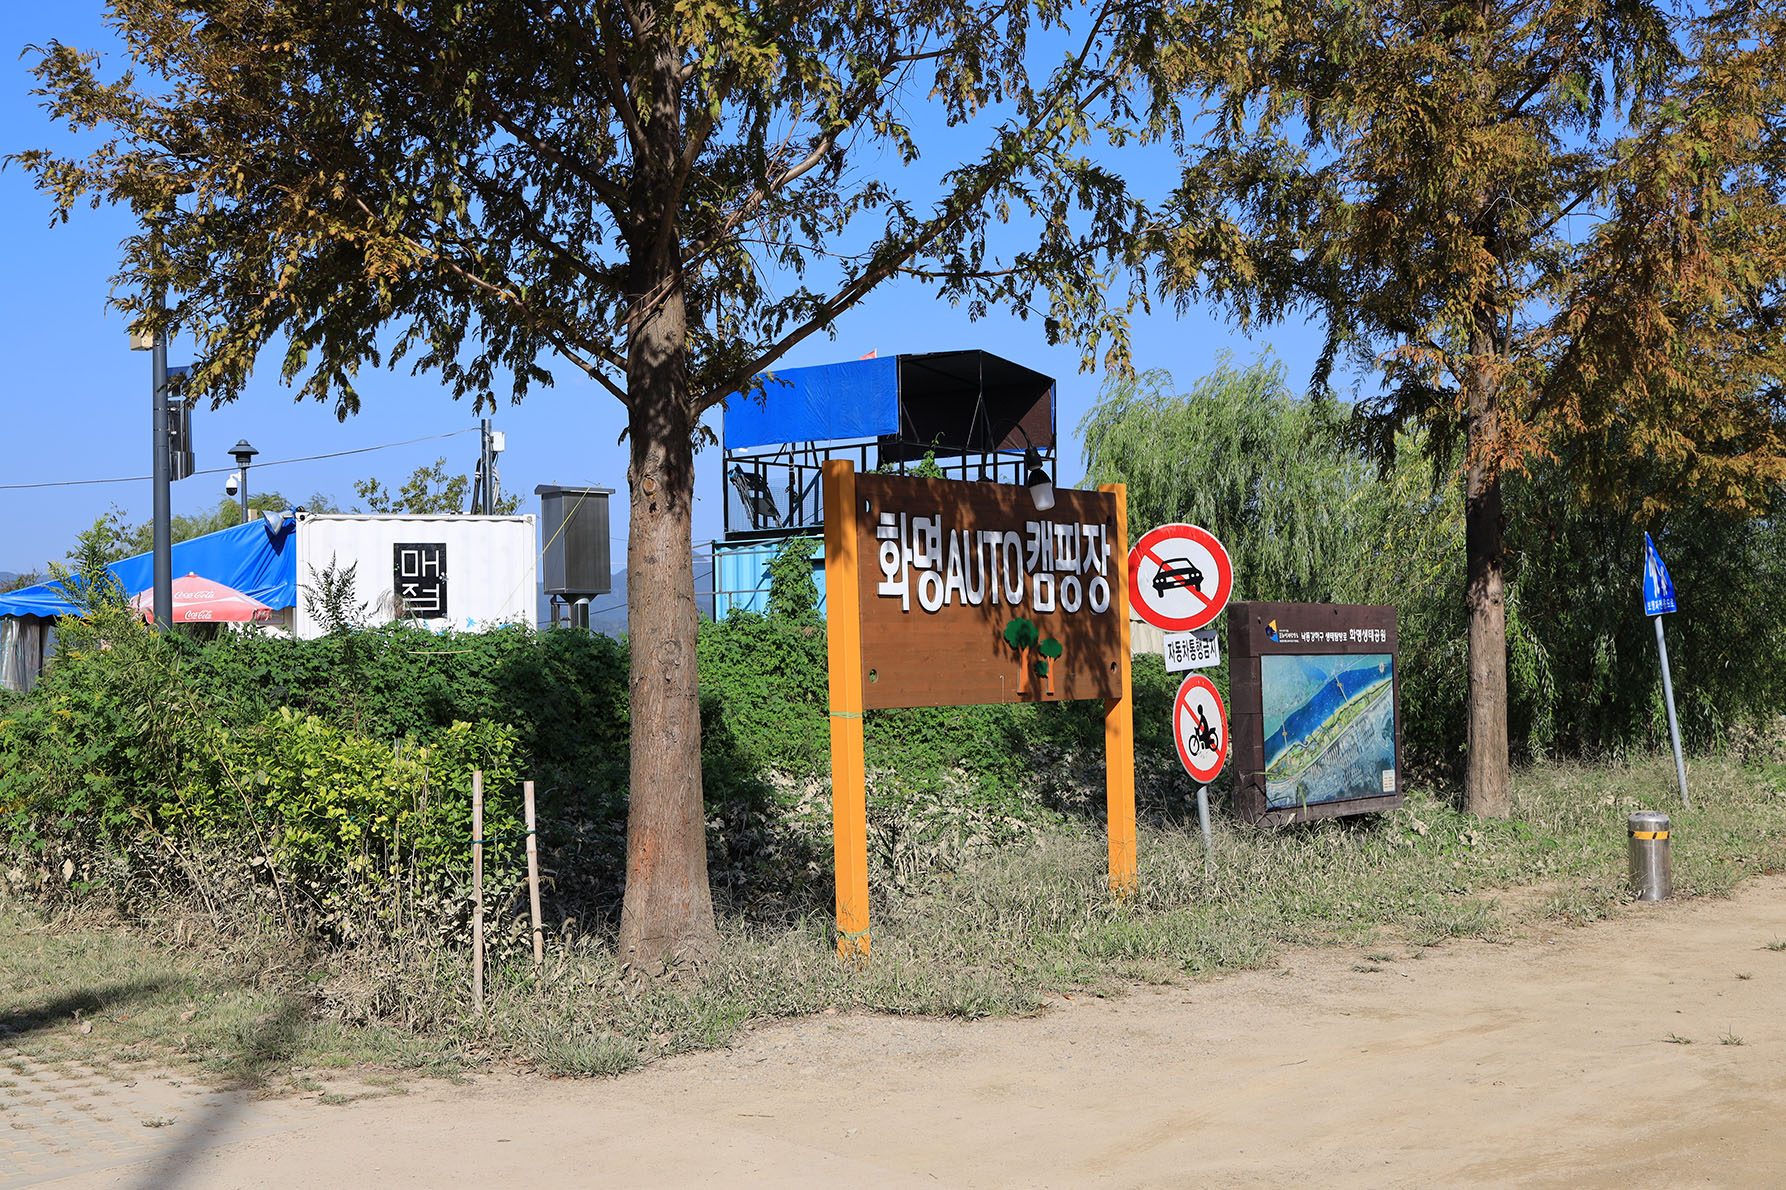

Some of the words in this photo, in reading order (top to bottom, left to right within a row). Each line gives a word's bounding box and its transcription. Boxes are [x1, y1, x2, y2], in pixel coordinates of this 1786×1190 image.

[401, 550, 440, 611] 매점
[1349, 628, 1387, 643] 화명생태공원
[1167, 636, 1218, 663] 자동차통행금지
